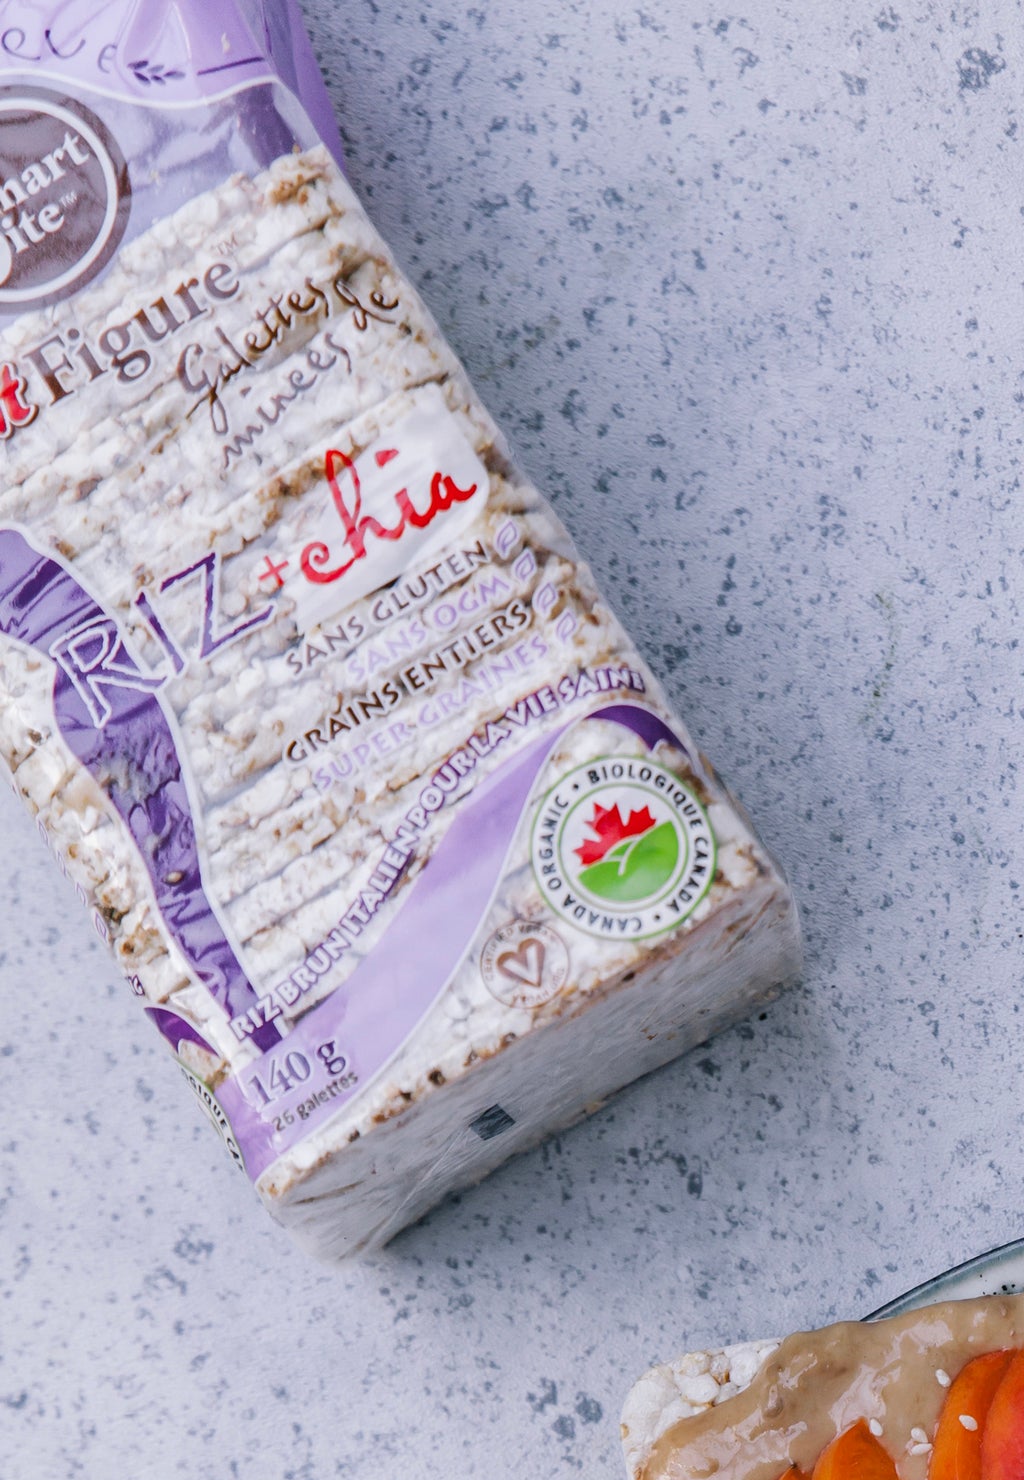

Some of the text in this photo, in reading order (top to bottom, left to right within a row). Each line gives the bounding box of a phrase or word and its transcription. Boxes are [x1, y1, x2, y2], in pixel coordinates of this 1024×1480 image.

[0, 131, 89, 211] mart
[0, 203, 65, 285] ite
[177, 277, 329, 434] Galettes
[50, 551, 275, 728] RIZ
[286, 540, 488, 675] SANS GLUTEN
[350, 575, 510, 681] SANS OGM
[286, 603, 528, 763] GRAINS ENTIERS
[315, 636, 547, 789] SUPER GRAINES
[228, 994, 283, 1041] RIZ
[275, 928, 351, 1007] BRUN
[340, 826, 420, 937] ITALIEN
[407, 748, 477, 830] POUR
[467, 721, 513, 757] LA
[505, 685, 560, 727] VIE
[539, 795, 643, 932] CANADA ORGANIC
[587, 764, 709, 913] BIOLOGIQUE CANADA
[250, 1040, 346, 1105] 140 g
[272, 1071, 359, 1132] 26 galettes
